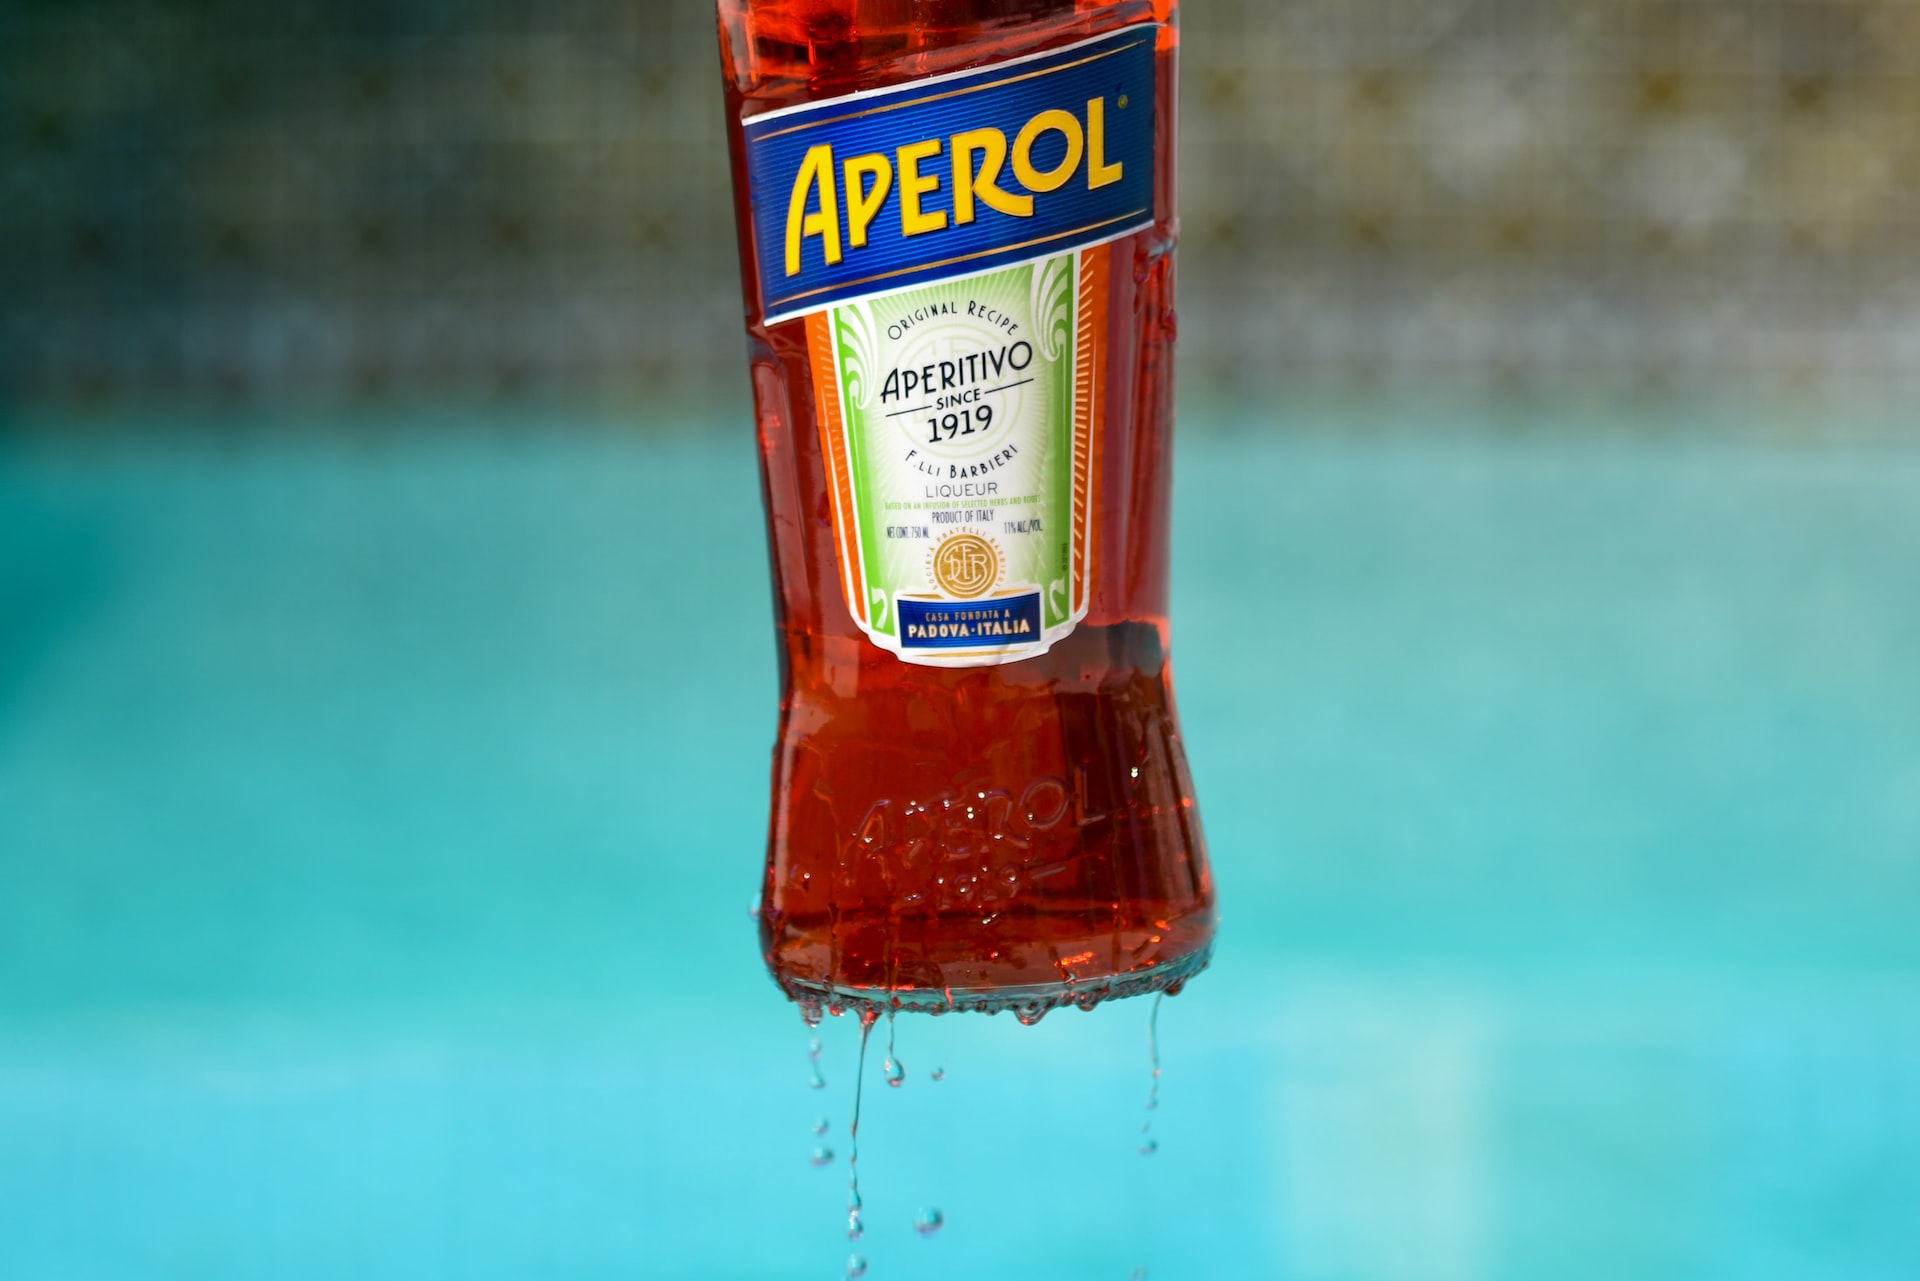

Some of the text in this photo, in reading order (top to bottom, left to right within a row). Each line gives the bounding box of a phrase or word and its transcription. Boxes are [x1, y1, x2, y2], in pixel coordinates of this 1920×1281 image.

[785, 96, 1123, 277] APEROL
[887, 300, 1019, 340] ORIGINAL RECIPE
[880, 340, 1033, 404] APERITIVO
[936, 388, 981, 411] SINCE
[927, 404, 993, 443] 1919
[904, 444, 1018, 479] F.LLI BARBIERI
[925, 482, 999, 499] LIQUEUR
[951, 500, 959, 509] OF
[1009, 496, 1021, 505] AND
[931, 508, 995, 524] PRODUCT OF ITALY
[886, 526, 895, 539] NET
[911, 526, 921, 539] 750
[936, 526, 986, 542] FRATELLI
[1004, 521, 1016, 535] 11%
[925, 608, 1011, 622] CASA FONDATA A
